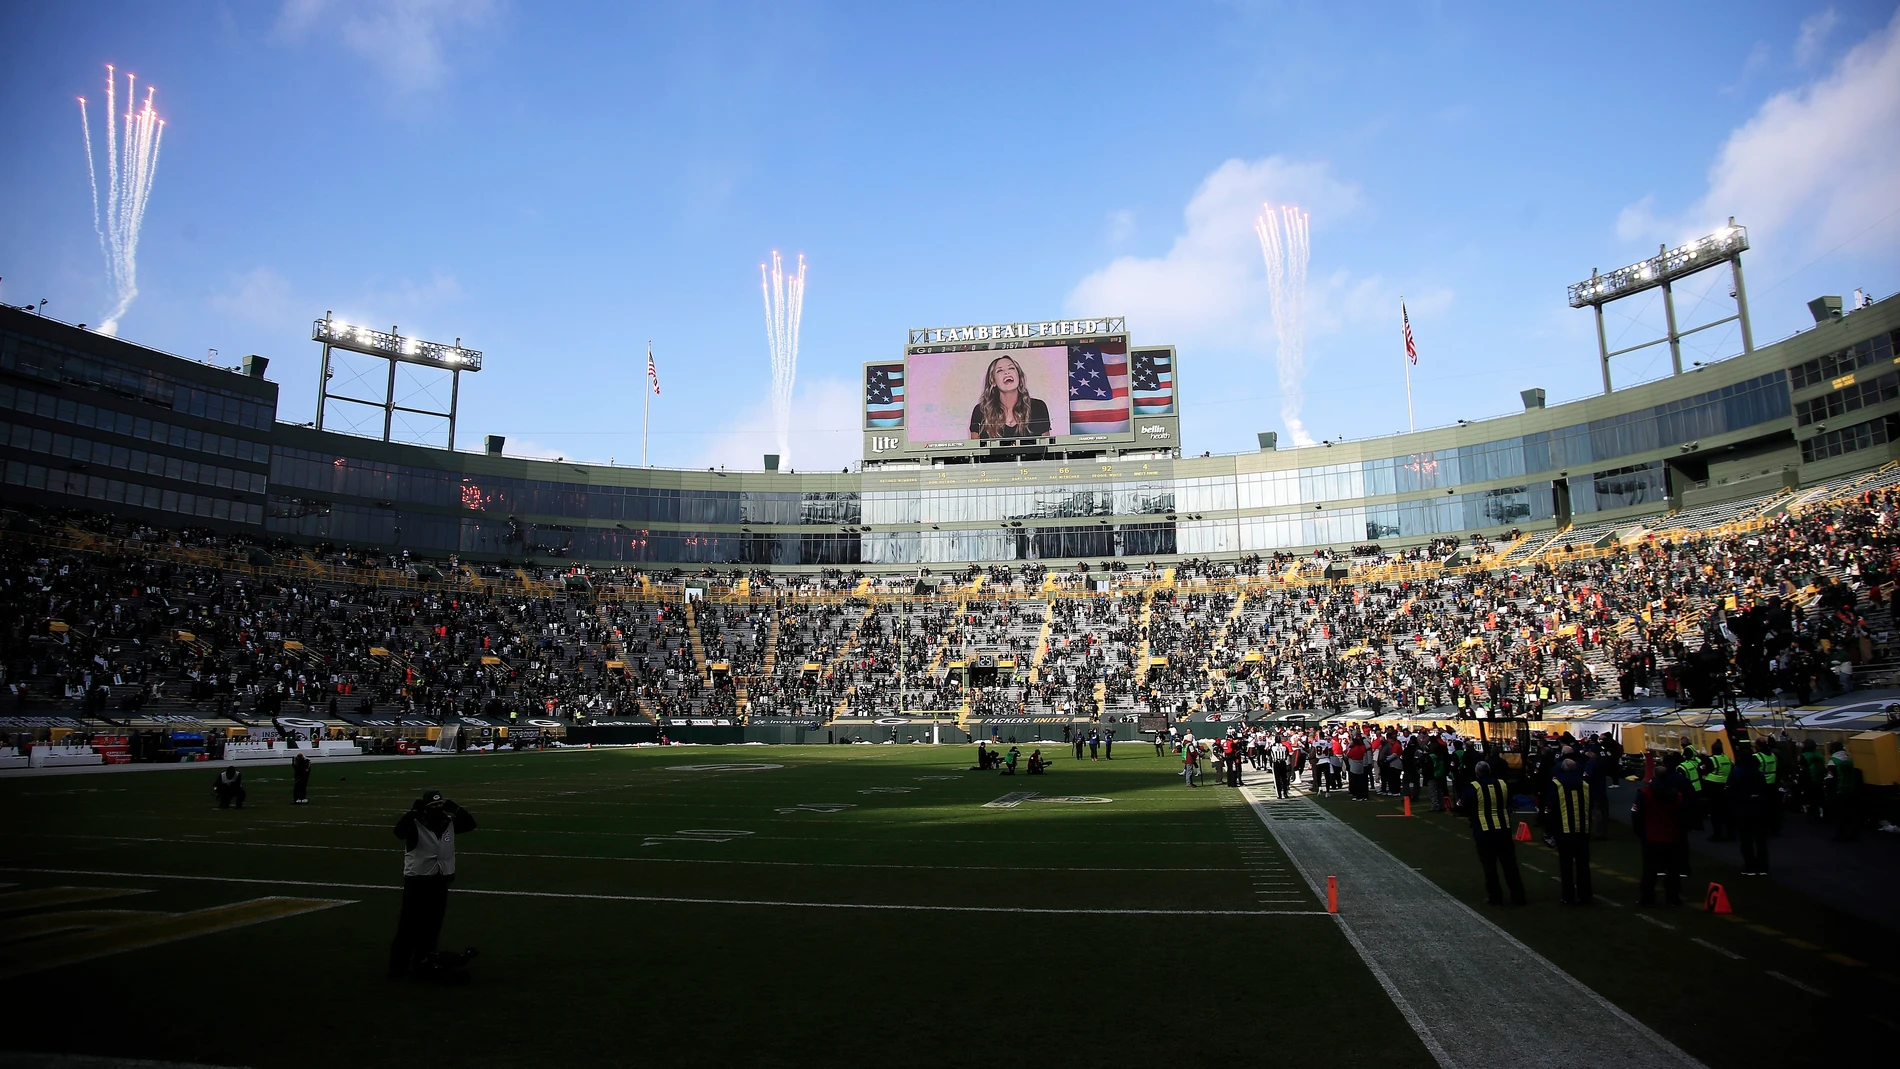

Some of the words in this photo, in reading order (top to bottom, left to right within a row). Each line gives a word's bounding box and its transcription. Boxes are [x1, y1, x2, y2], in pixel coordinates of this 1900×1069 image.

[937, 324, 1030, 342] LAMBEAU
[1039, 320, 1098, 337] FIELD
[1002, 342, 1019, 350] 3:57
[1141, 425, 1165, 434] bellin
[1151, 432, 1171, 440] health
[872, 436, 899, 454] Lite
[980, 656, 992, 666] 25
[1316, 746, 1329, 756] 84
[1707, 885, 1720, 912] G
